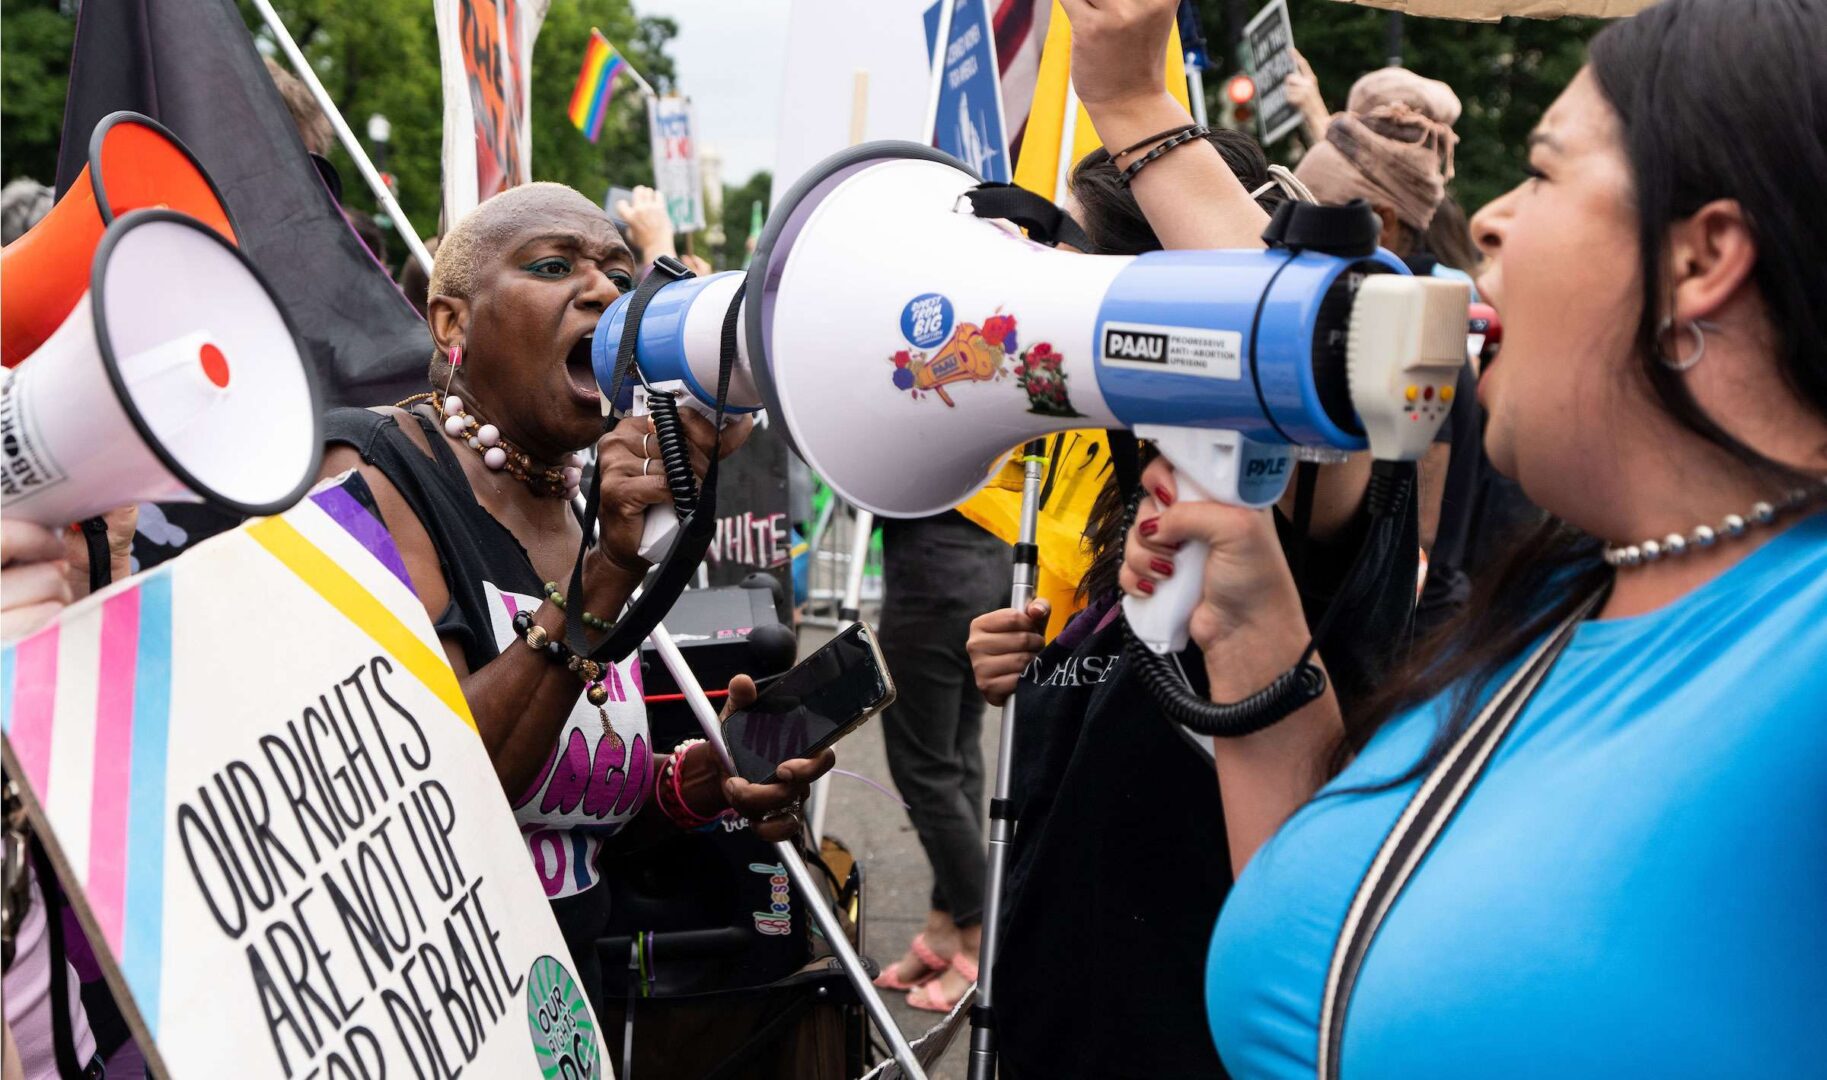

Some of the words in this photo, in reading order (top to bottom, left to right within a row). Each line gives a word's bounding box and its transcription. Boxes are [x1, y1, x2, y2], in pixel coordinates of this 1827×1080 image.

[913, 314, 943, 337] BIG
[1107, 333, 1164, 360] PAAU
[1170, 336, 1226, 349] PROGRESSIVE
[1170, 357, 1208, 369] UPRISING
[1246, 457, 1287, 477] PYLE
[1042, 654, 1120, 688] HASE
[177, 760, 306, 940] OUR
[258, 655, 432, 864] RIGHTS
[748, 862, 792, 935] Blessed
[245, 887, 365, 1080] ARE
[321, 816, 428, 992] NOT
[398, 779, 467, 902] UP
[381, 875, 524, 1080] DEBATE
[538, 986, 566, 1034] OUR
[549, 1008, 577, 1059] RIGHTS
[558, 1032, 592, 1080] DC
